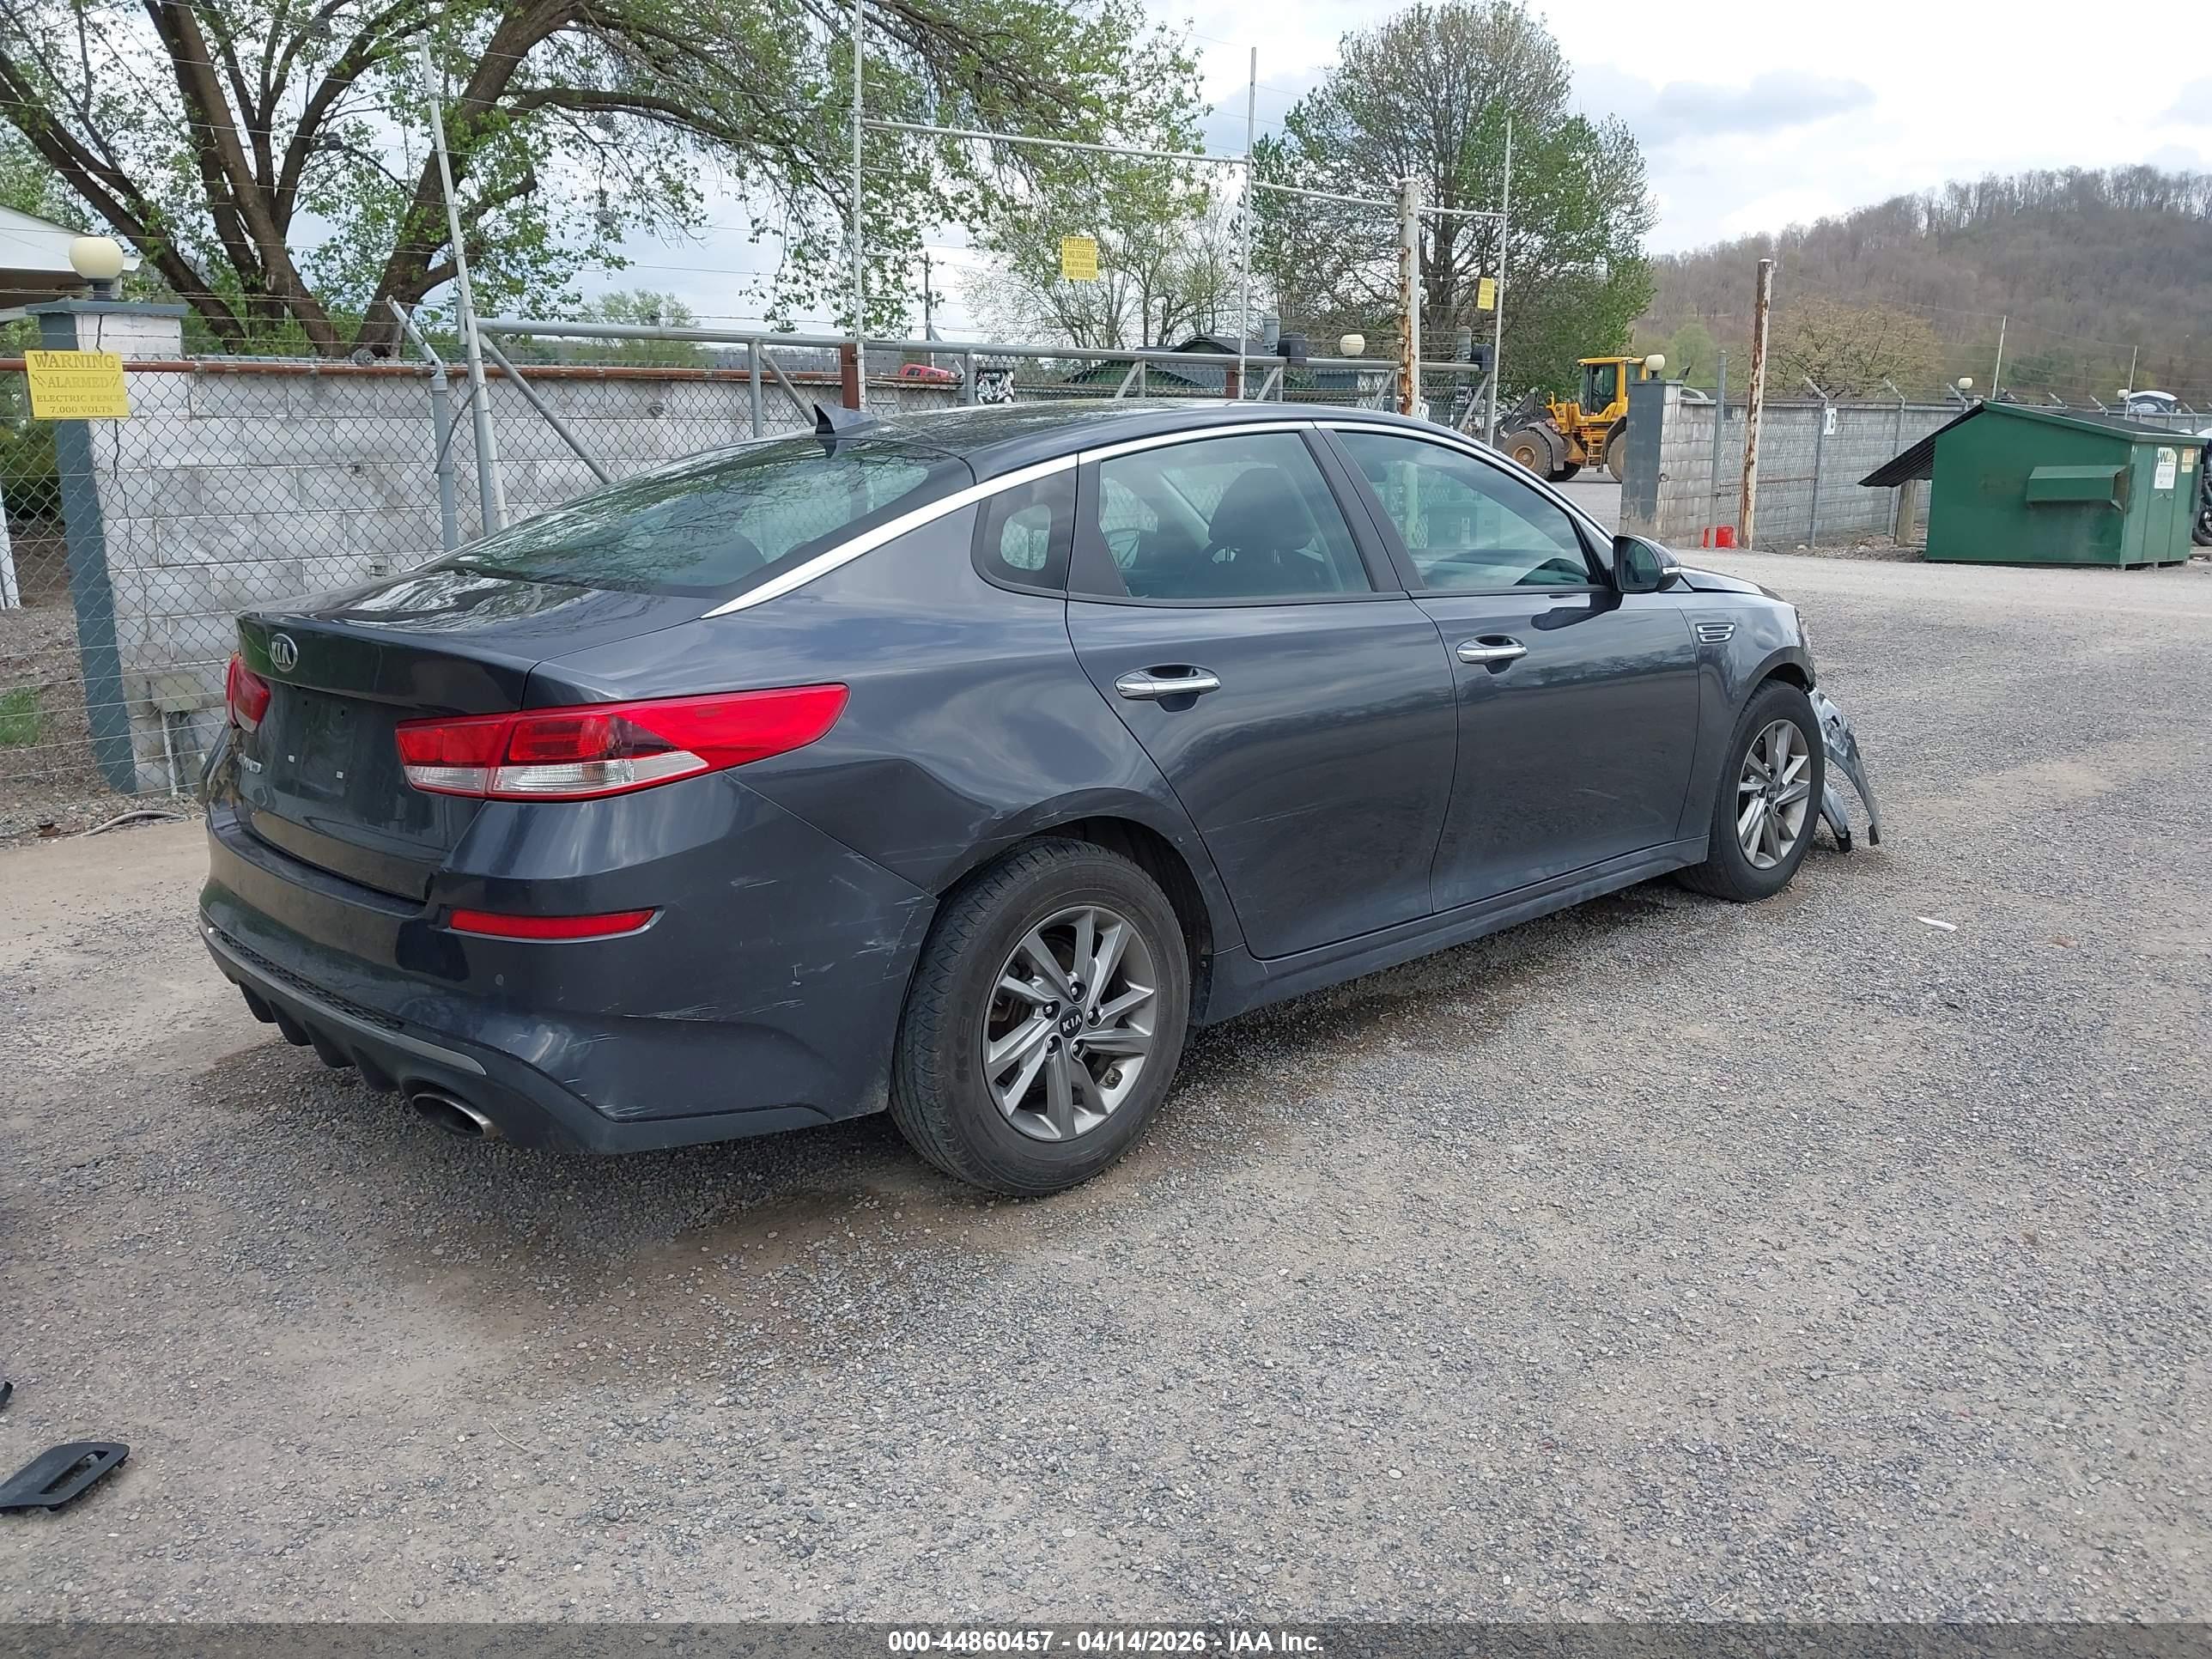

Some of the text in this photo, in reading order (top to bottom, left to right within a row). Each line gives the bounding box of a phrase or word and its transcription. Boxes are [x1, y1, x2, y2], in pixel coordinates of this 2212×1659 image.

[33, 354, 116, 368] WARNING
[47, 376, 109, 389] ALARMED
[36, 394, 124, 403] ELECTRIC FENCE
[270, 641, 292, 665] KIA
[1061, 1013, 1082, 1032] KIA
